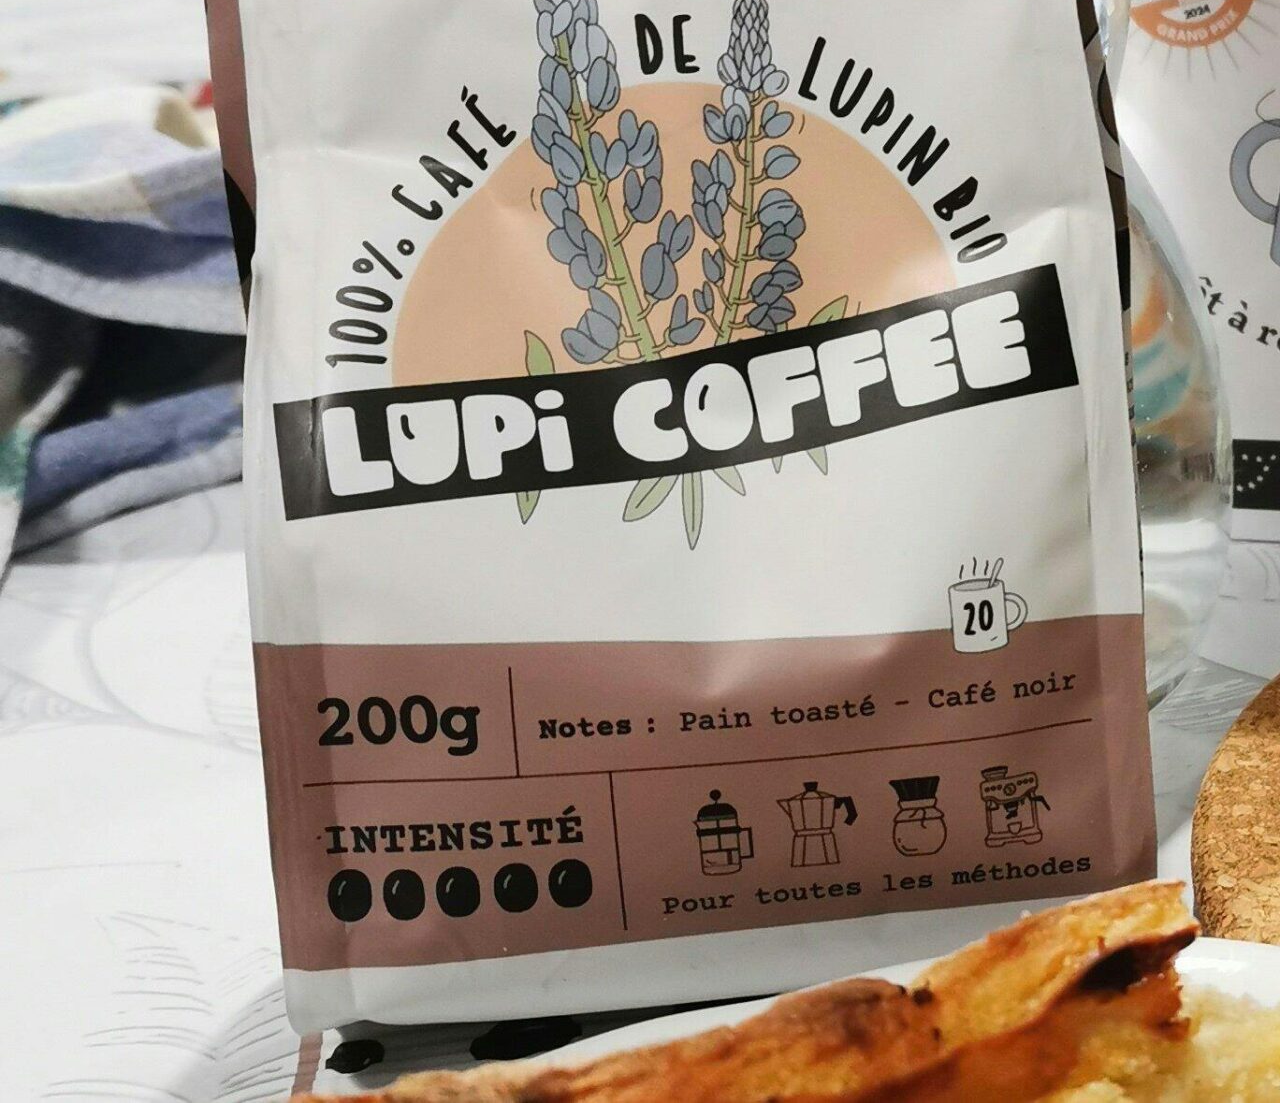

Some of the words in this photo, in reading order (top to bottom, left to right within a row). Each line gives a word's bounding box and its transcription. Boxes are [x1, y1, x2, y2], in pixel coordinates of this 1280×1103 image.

[1156, 24, 1209, 42] GRAND
[326, 238, 415, 366] 100%
[390, 85, 518, 222] CAFÉ
[633, 13, 701, 75] DE
[797, 36, 950, 188] LUPIN
[932, 176, 1008, 264] BIO
[1228, 300, 1249, 334] à
[612, 289, 1032, 463] COFFEE
[962, 599, 994, 636] 20
[317, 694, 481, 756] 200g
[538, 716, 633, 740] Notes
[679, 708, 752, 732] Pain
[770, 695, 877, 724] toasté
[927, 680, 997, 710] Café
[1013, 672, 1078, 699] noir
[324, 805, 584, 854] INTENSITÉ
[662, 894, 735, 915] Pour
[755, 879, 862, 906] toutes
[882, 874, 933, 893] les
[951, 855, 1092, 886] méthodes
